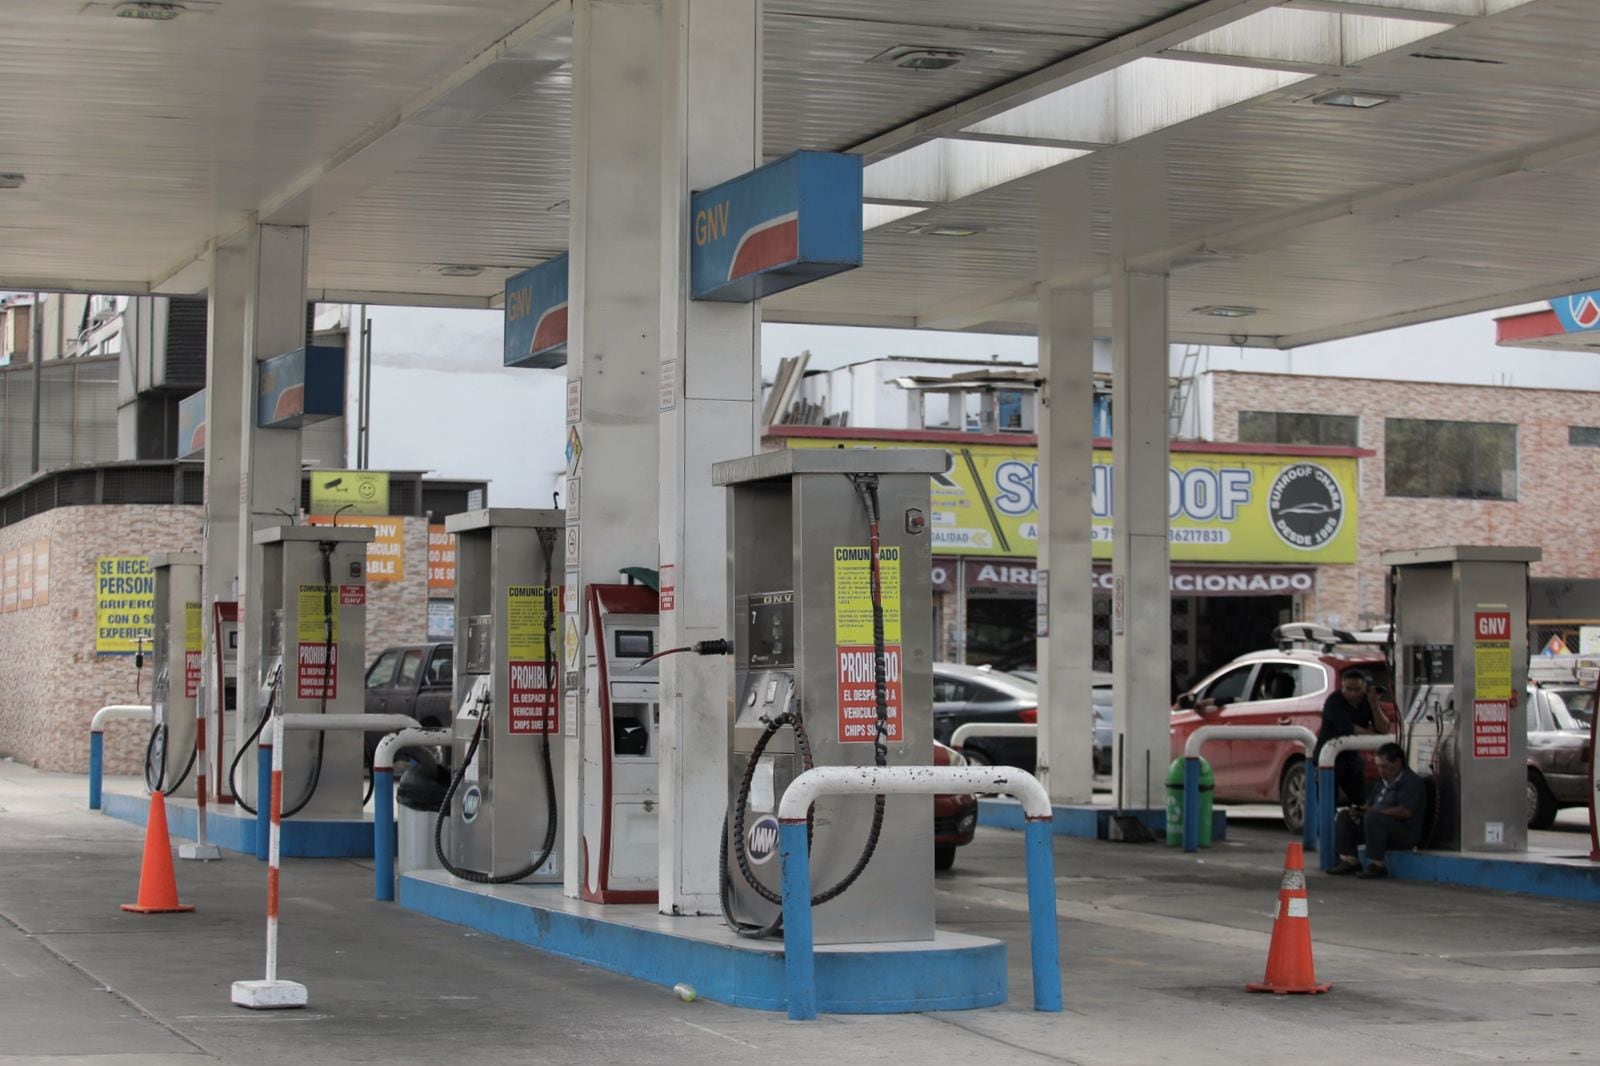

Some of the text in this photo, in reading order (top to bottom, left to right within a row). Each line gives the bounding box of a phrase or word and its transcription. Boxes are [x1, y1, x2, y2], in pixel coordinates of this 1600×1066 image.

[695, 201, 730, 247] GNV
[509, 286, 533, 321] GNV
[836, 549, 898, 561] COMUNADO
[101, 560, 113, 574] SE
[509, 587, 557, 596] COMUNICO
[108, 613, 128, 624] CON
[133, 613, 139, 624] O
[1479, 617, 1506, 635] GNV
[300, 646, 335, 665] PROHIBIO
[840, 652, 898, 683] PROHIDO
[511, 666, 557, 689] PROHIBIO
[521, 694, 545, 702] DESPACH
[844, 689, 896, 701] EL DESPAO A
[844, 707, 878, 719] VEHICULO
[845, 725, 866, 736] CHIPS
